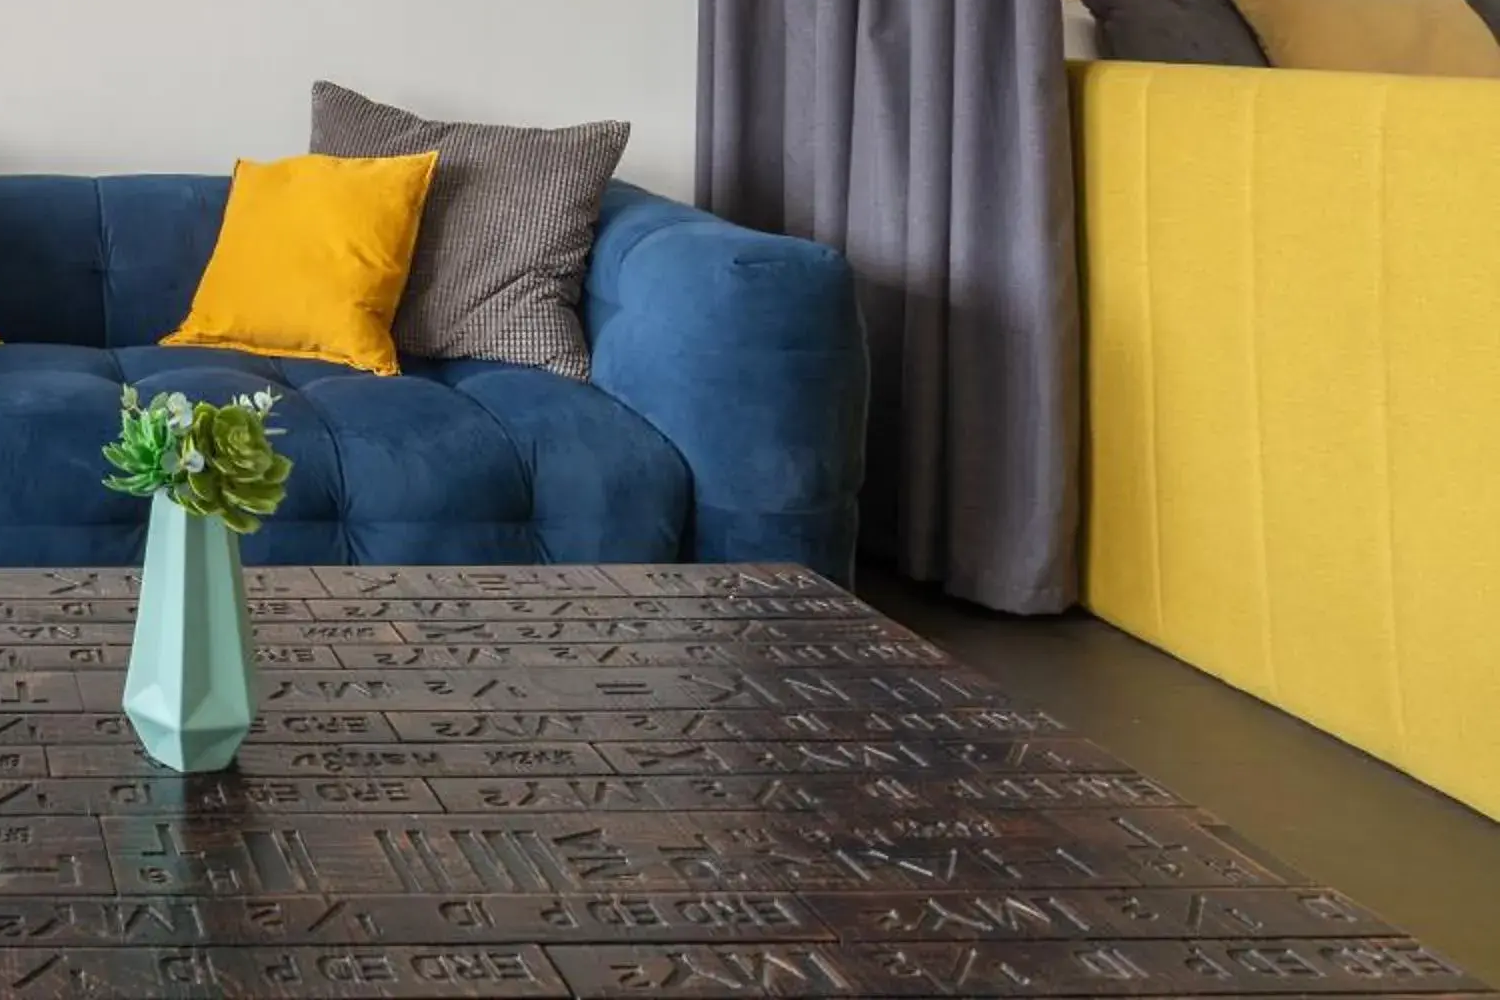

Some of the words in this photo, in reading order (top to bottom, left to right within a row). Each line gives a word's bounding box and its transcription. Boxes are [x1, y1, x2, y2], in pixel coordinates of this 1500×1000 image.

[311, 783, 412, 801] ERD
[431, 899, 500, 928] ID
[530, 900, 583, 927] P
[579, 899, 672, 926] ED
[668, 899, 806, 925] ERD
[152, 955, 217, 983] ID
[255, 955, 304, 982] P
[312, 954, 399, 982] ED
[405, 953, 540, 981] ERD
[1059, 948, 1154, 978] ID
